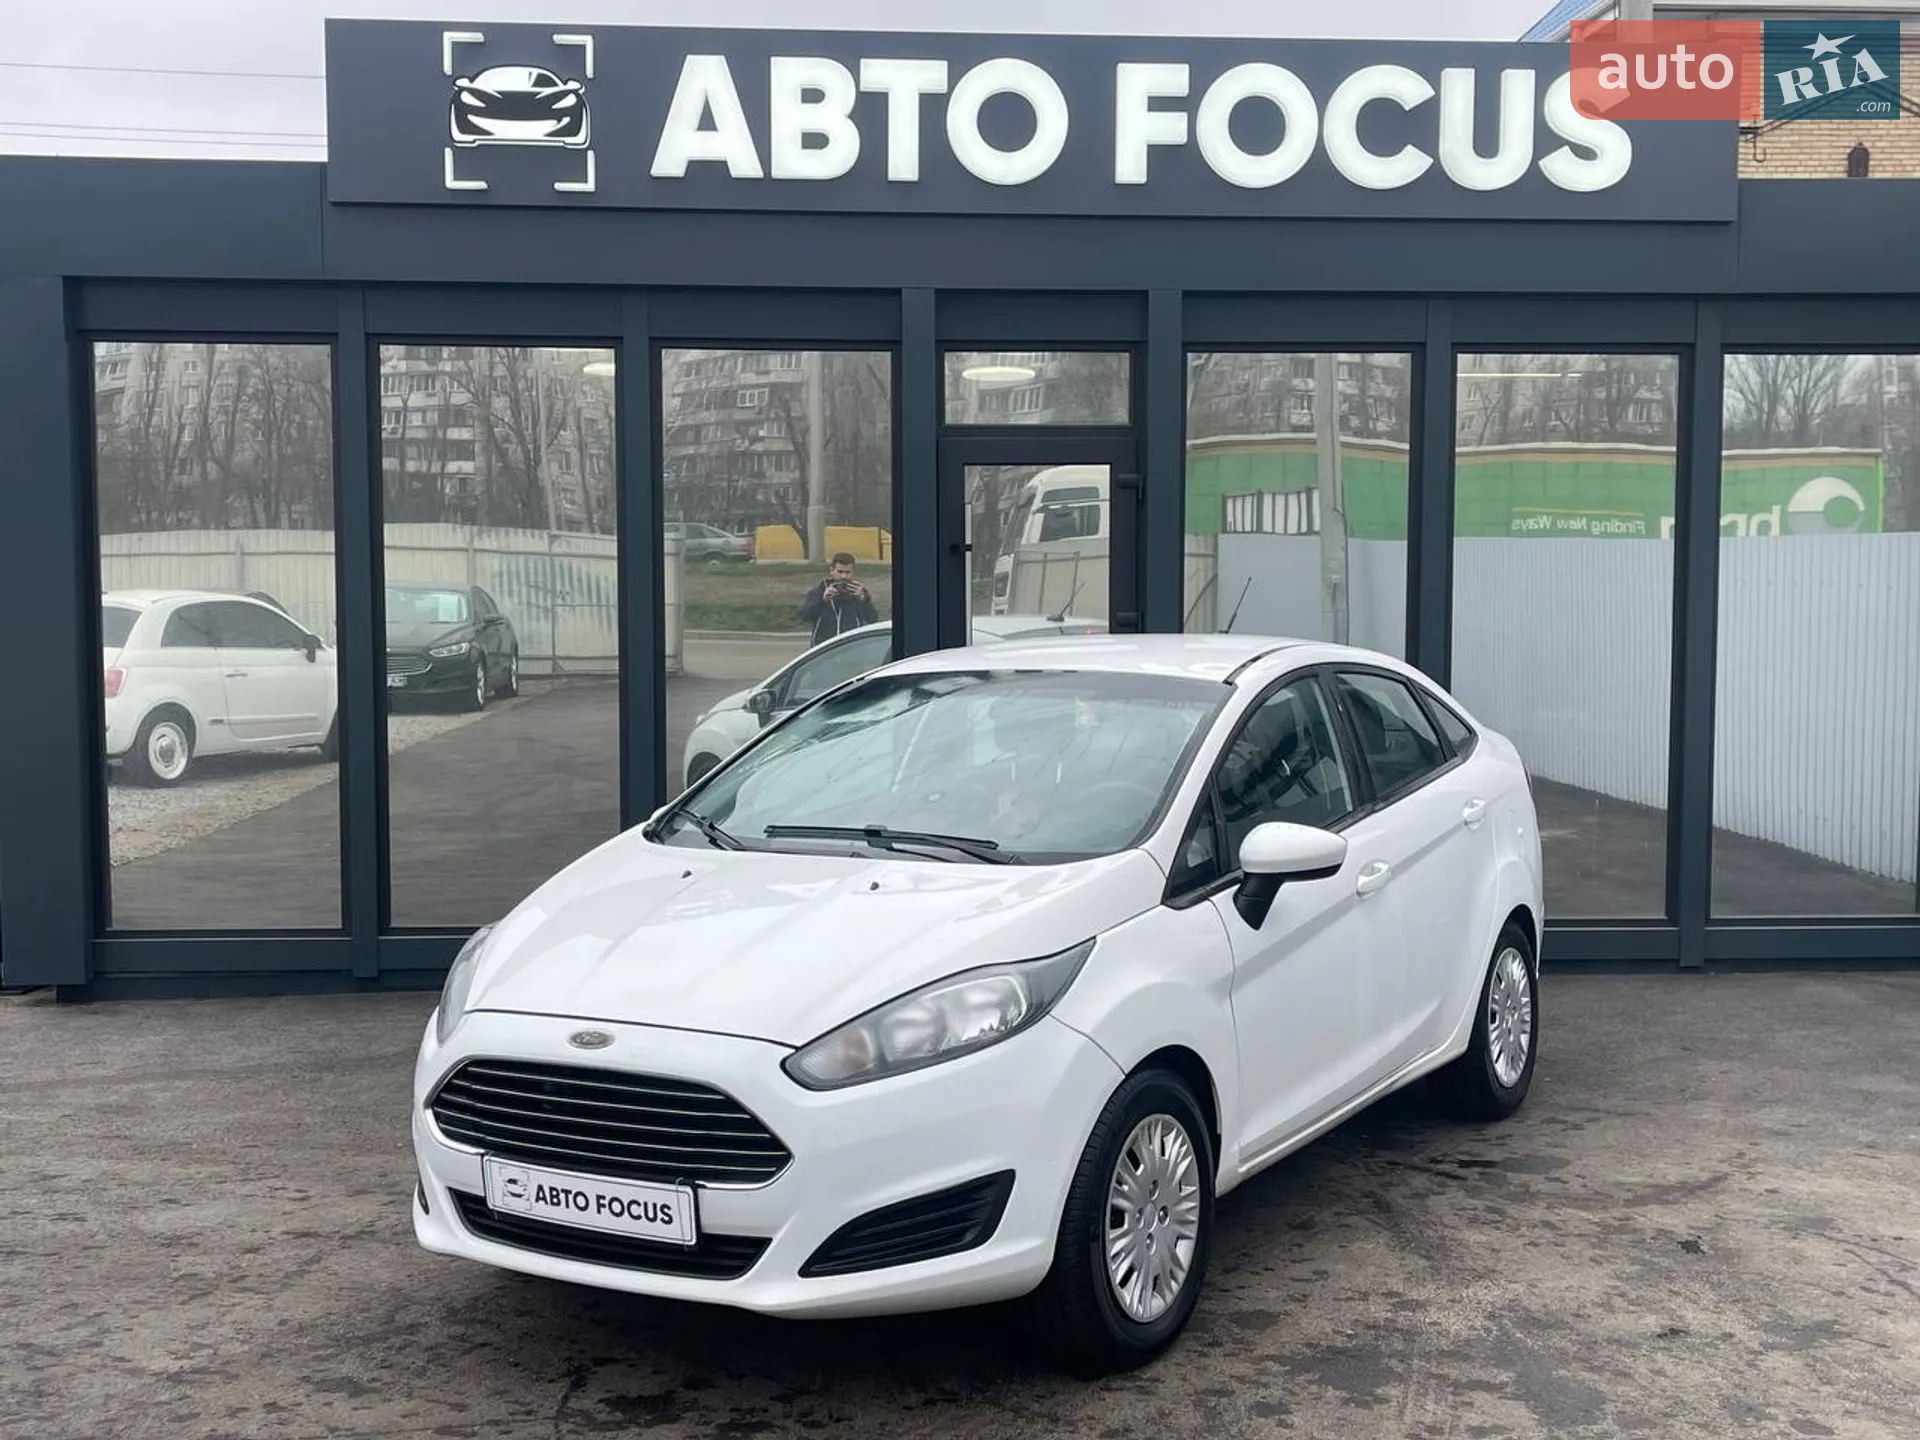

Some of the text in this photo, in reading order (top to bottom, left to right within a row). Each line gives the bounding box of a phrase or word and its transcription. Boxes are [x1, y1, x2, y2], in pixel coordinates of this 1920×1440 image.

[650, 54, 1633, 192] АВТО FOCUS
[534, 1184, 674, 1225] АВТО FOCUS
